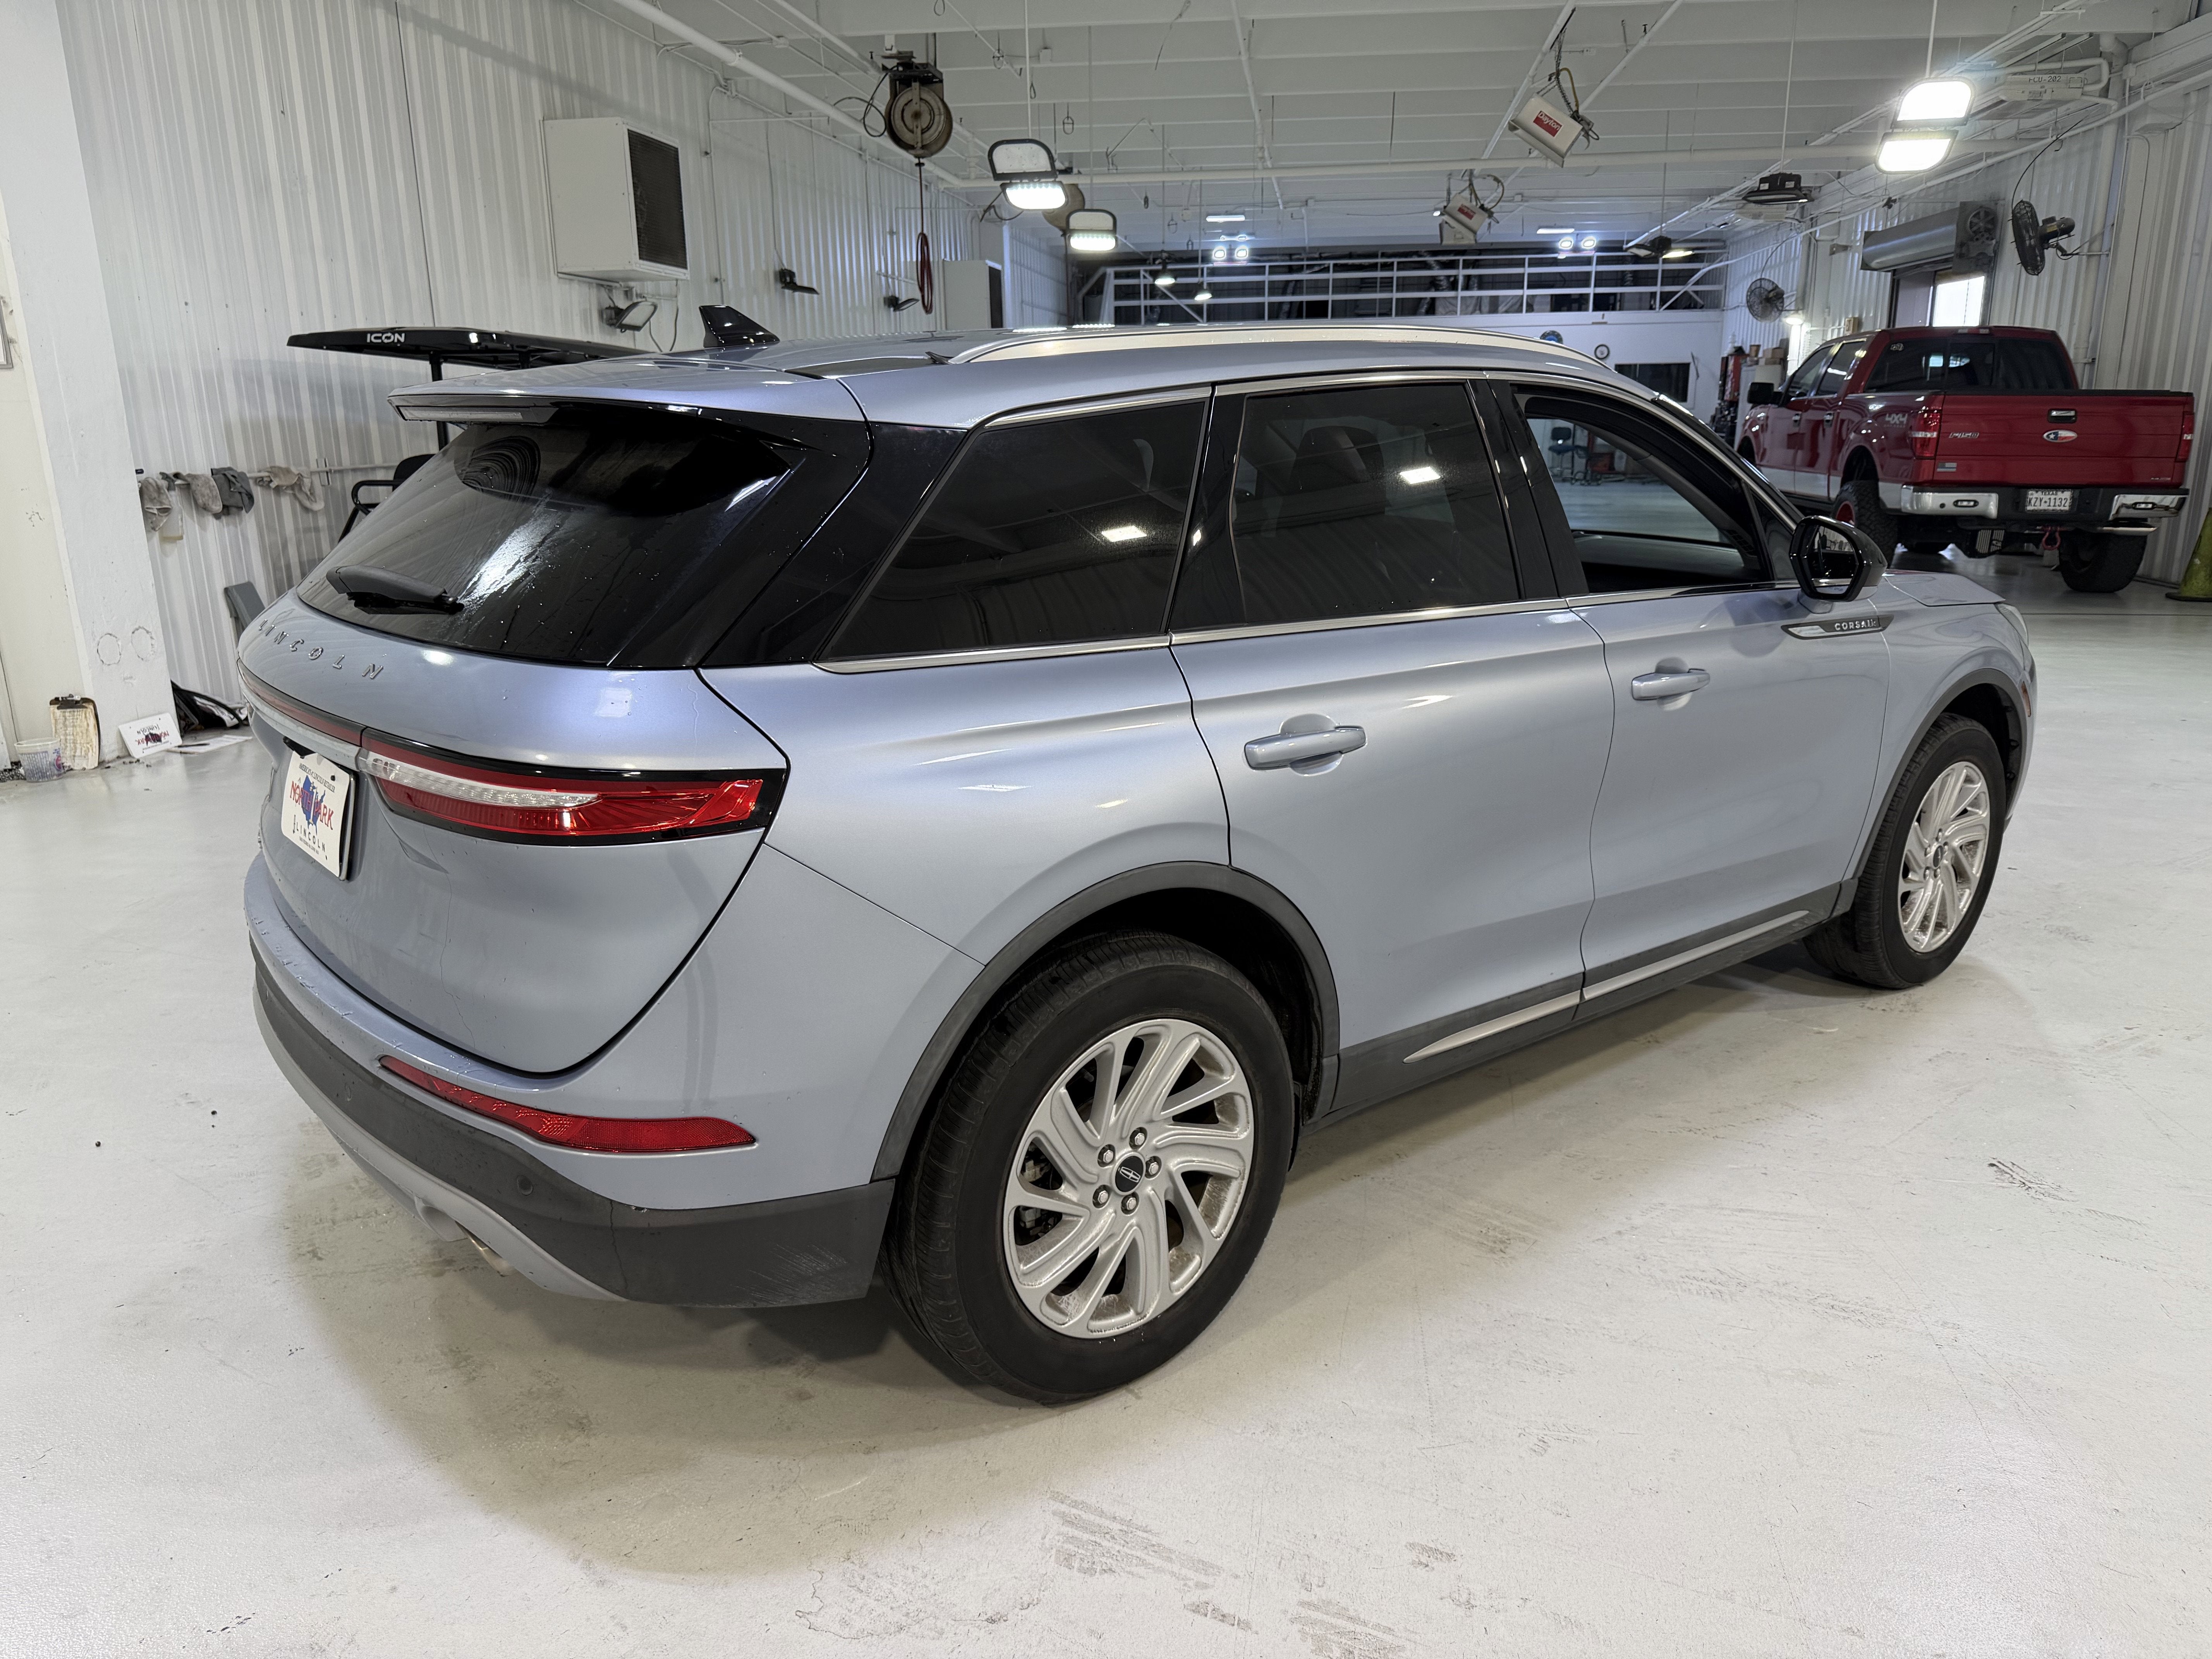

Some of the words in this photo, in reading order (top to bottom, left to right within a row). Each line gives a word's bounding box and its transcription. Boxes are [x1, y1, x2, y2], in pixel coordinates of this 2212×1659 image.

[1537, 112, 1561, 131] Dayton
[366, 332, 405, 343] ICON
[258, 619, 383, 679] LINCOLN
[290, 781, 313, 812] NORTH
[314, 799, 334, 830] PARK
[296, 822, 325, 852] LINCOLN
